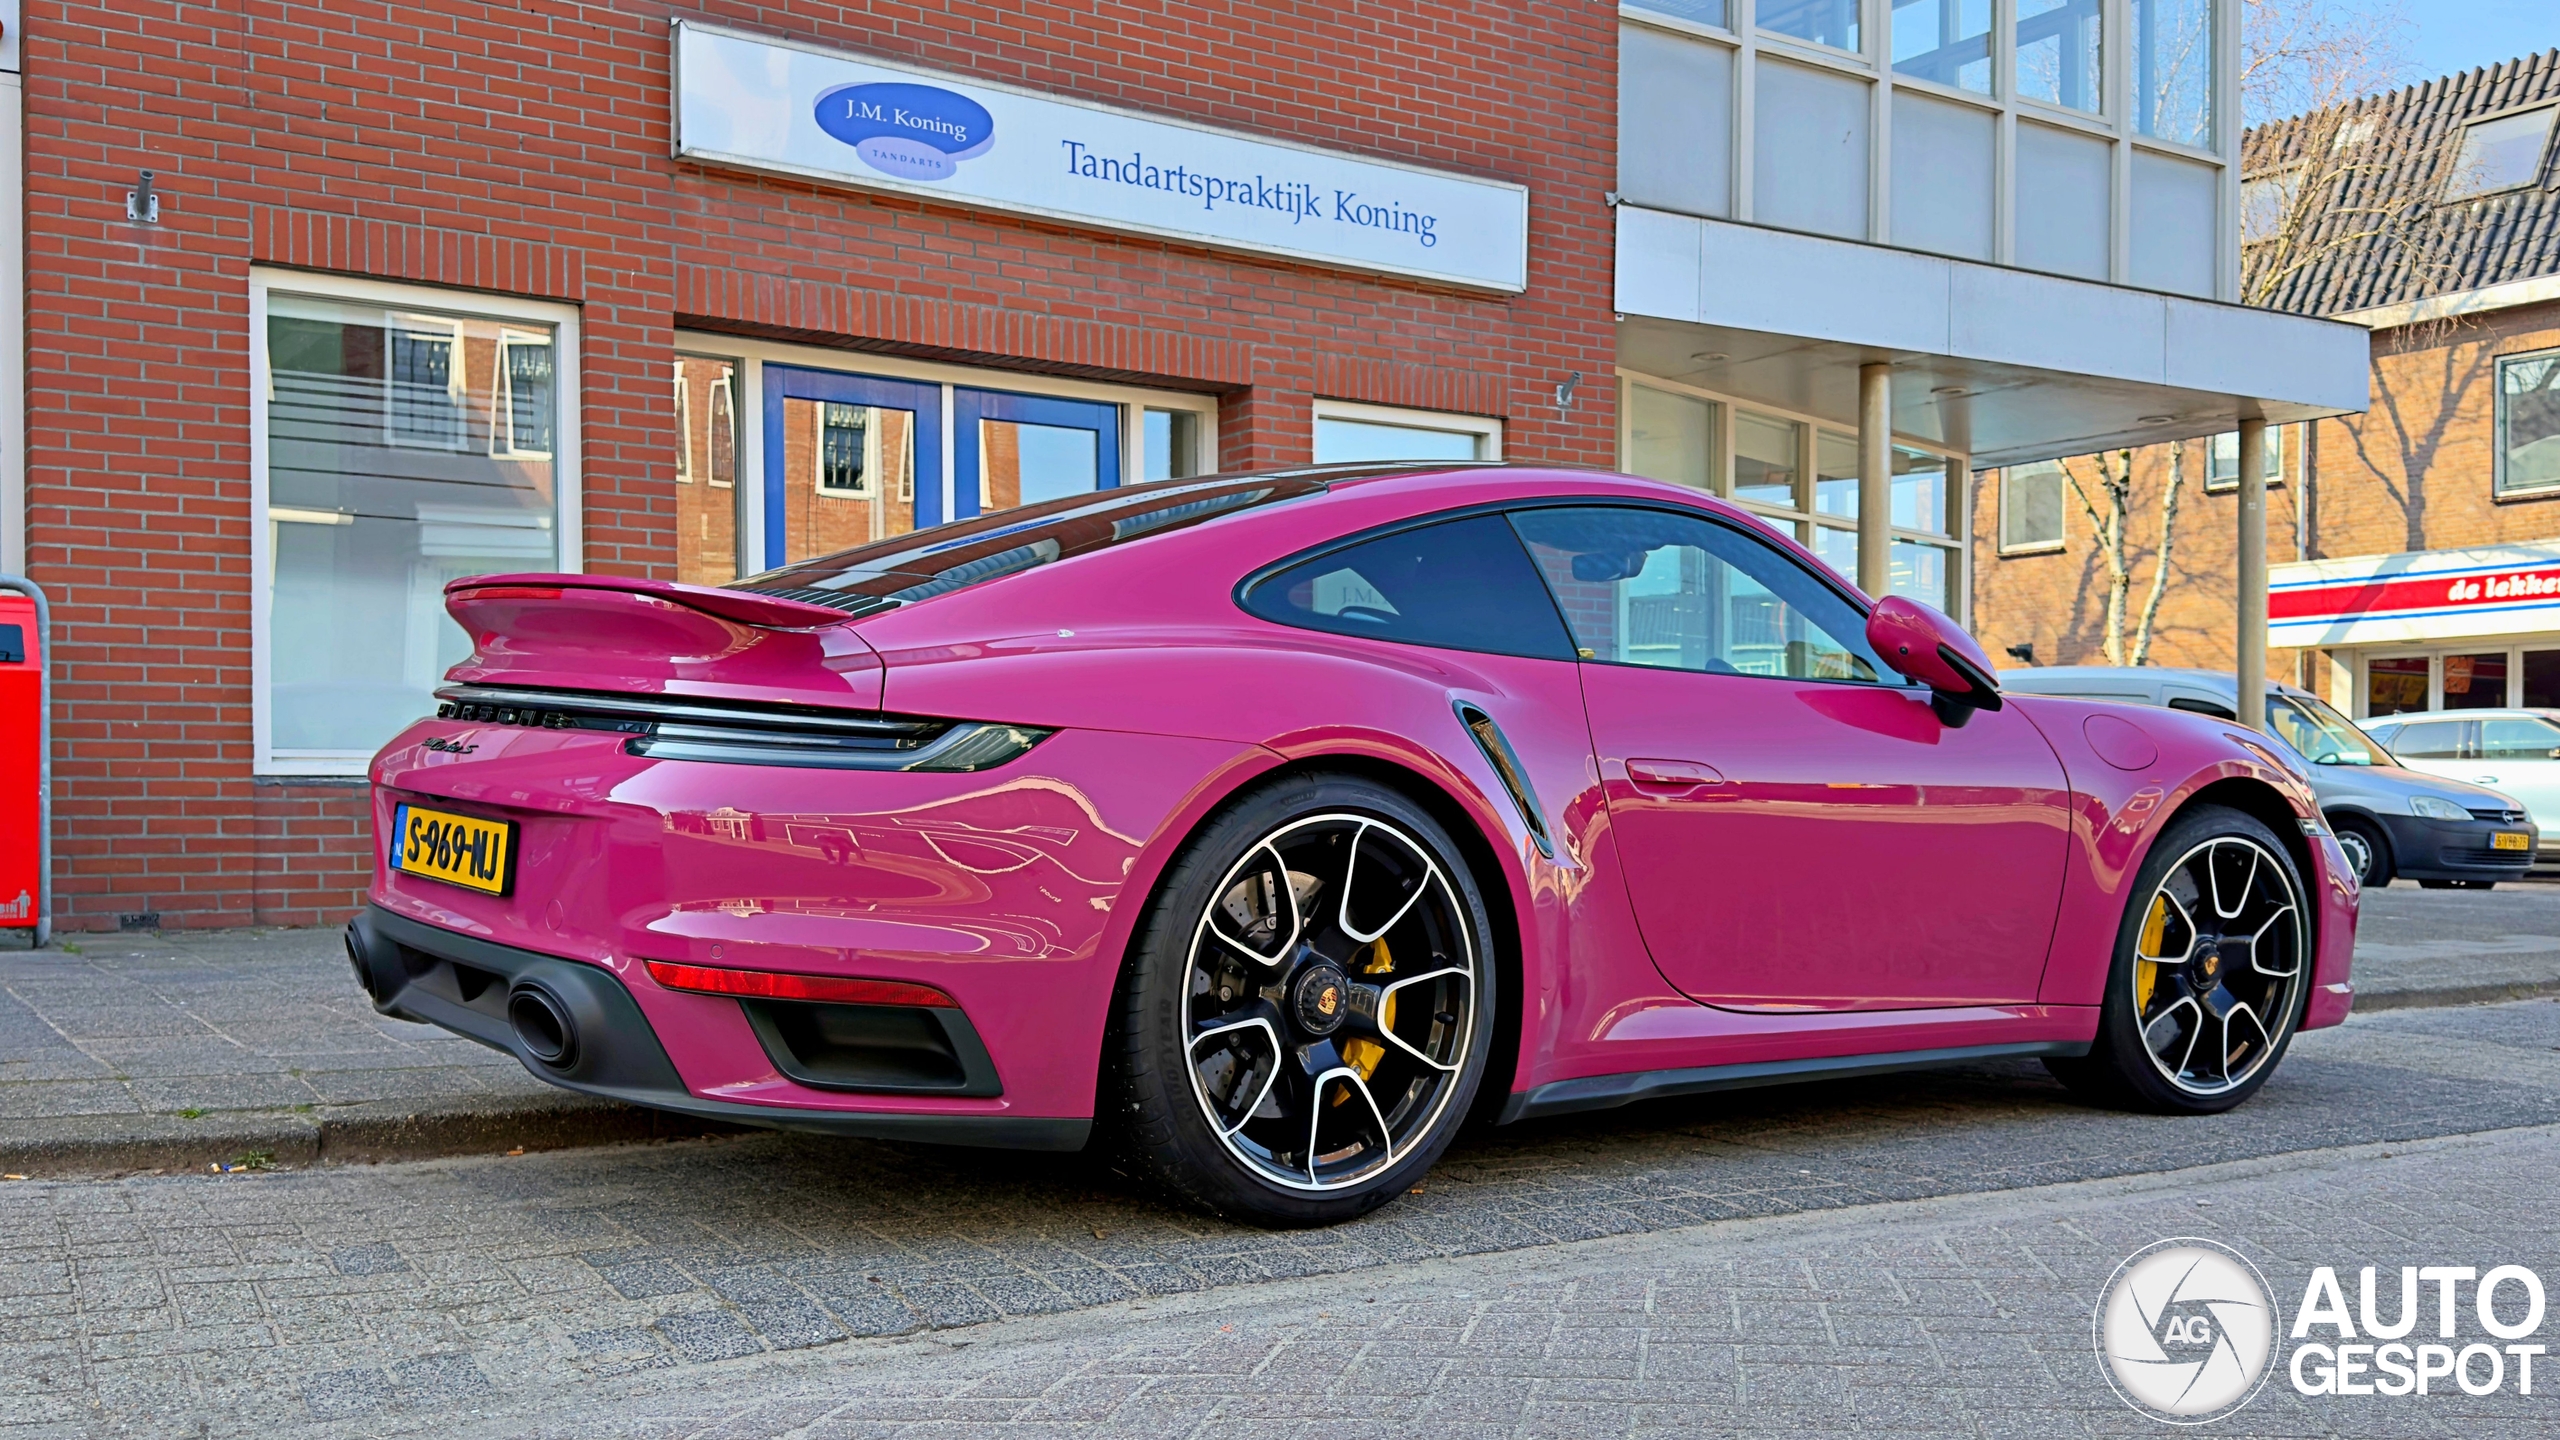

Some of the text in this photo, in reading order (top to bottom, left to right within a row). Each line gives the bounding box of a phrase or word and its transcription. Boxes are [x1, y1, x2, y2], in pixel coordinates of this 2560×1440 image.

[846, 99, 967, 142] J.M. Koning
[872, 149, 942, 169] TANDARTS
[1062, 139, 1437, 247] Tandartspraktijk Koning
[2448, 579, 2480, 601] de
[394, 842, 402, 857] NL
[407, 816, 500, 881] S-969-NJ
